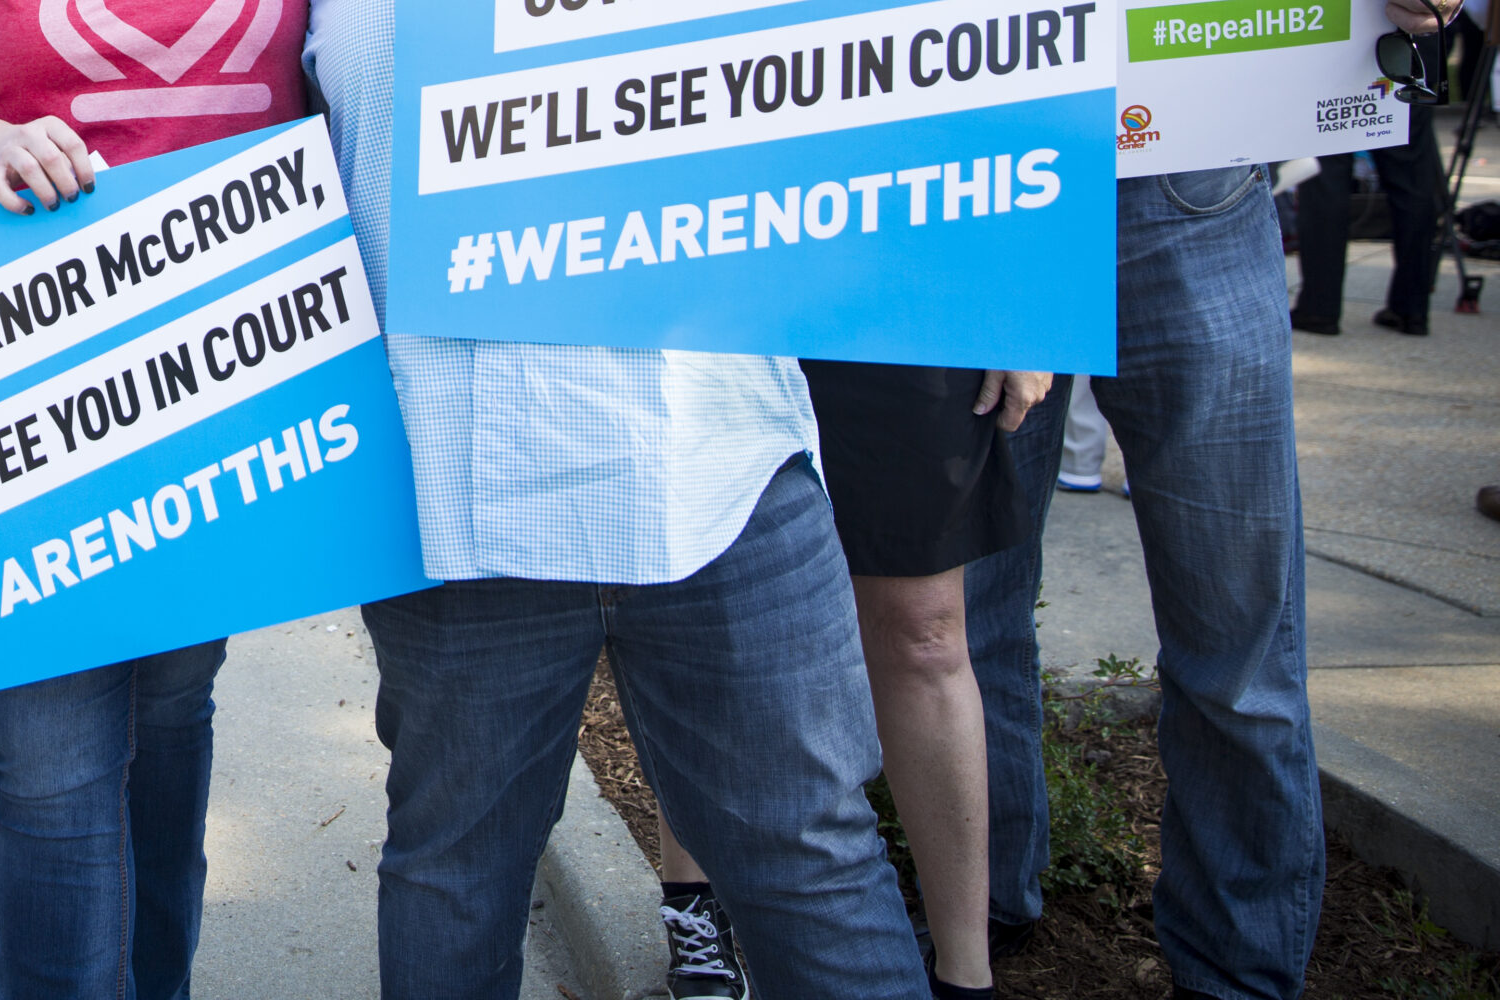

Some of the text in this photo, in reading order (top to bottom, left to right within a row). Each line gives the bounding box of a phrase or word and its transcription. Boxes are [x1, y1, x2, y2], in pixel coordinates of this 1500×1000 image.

[1153, 5, 1324, 48] #RepealHB2
[440, 1, 1097, 164] WE'LL SEE YOU IN COURT
[1316, 93, 1377, 108] NATIONAL
[1316, 103, 1377, 123] LGBTQ
[1316, 114, 1393, 133] TASK FORCE
[97, 147, 326, 297] McCRORY,
[446, 147, 1062, 295] #WEARENOTTHIS
[46, 371, 140, 454] YOU
[146, 342, 200, 412] IN
[202, 266, 353, 382] COURT
